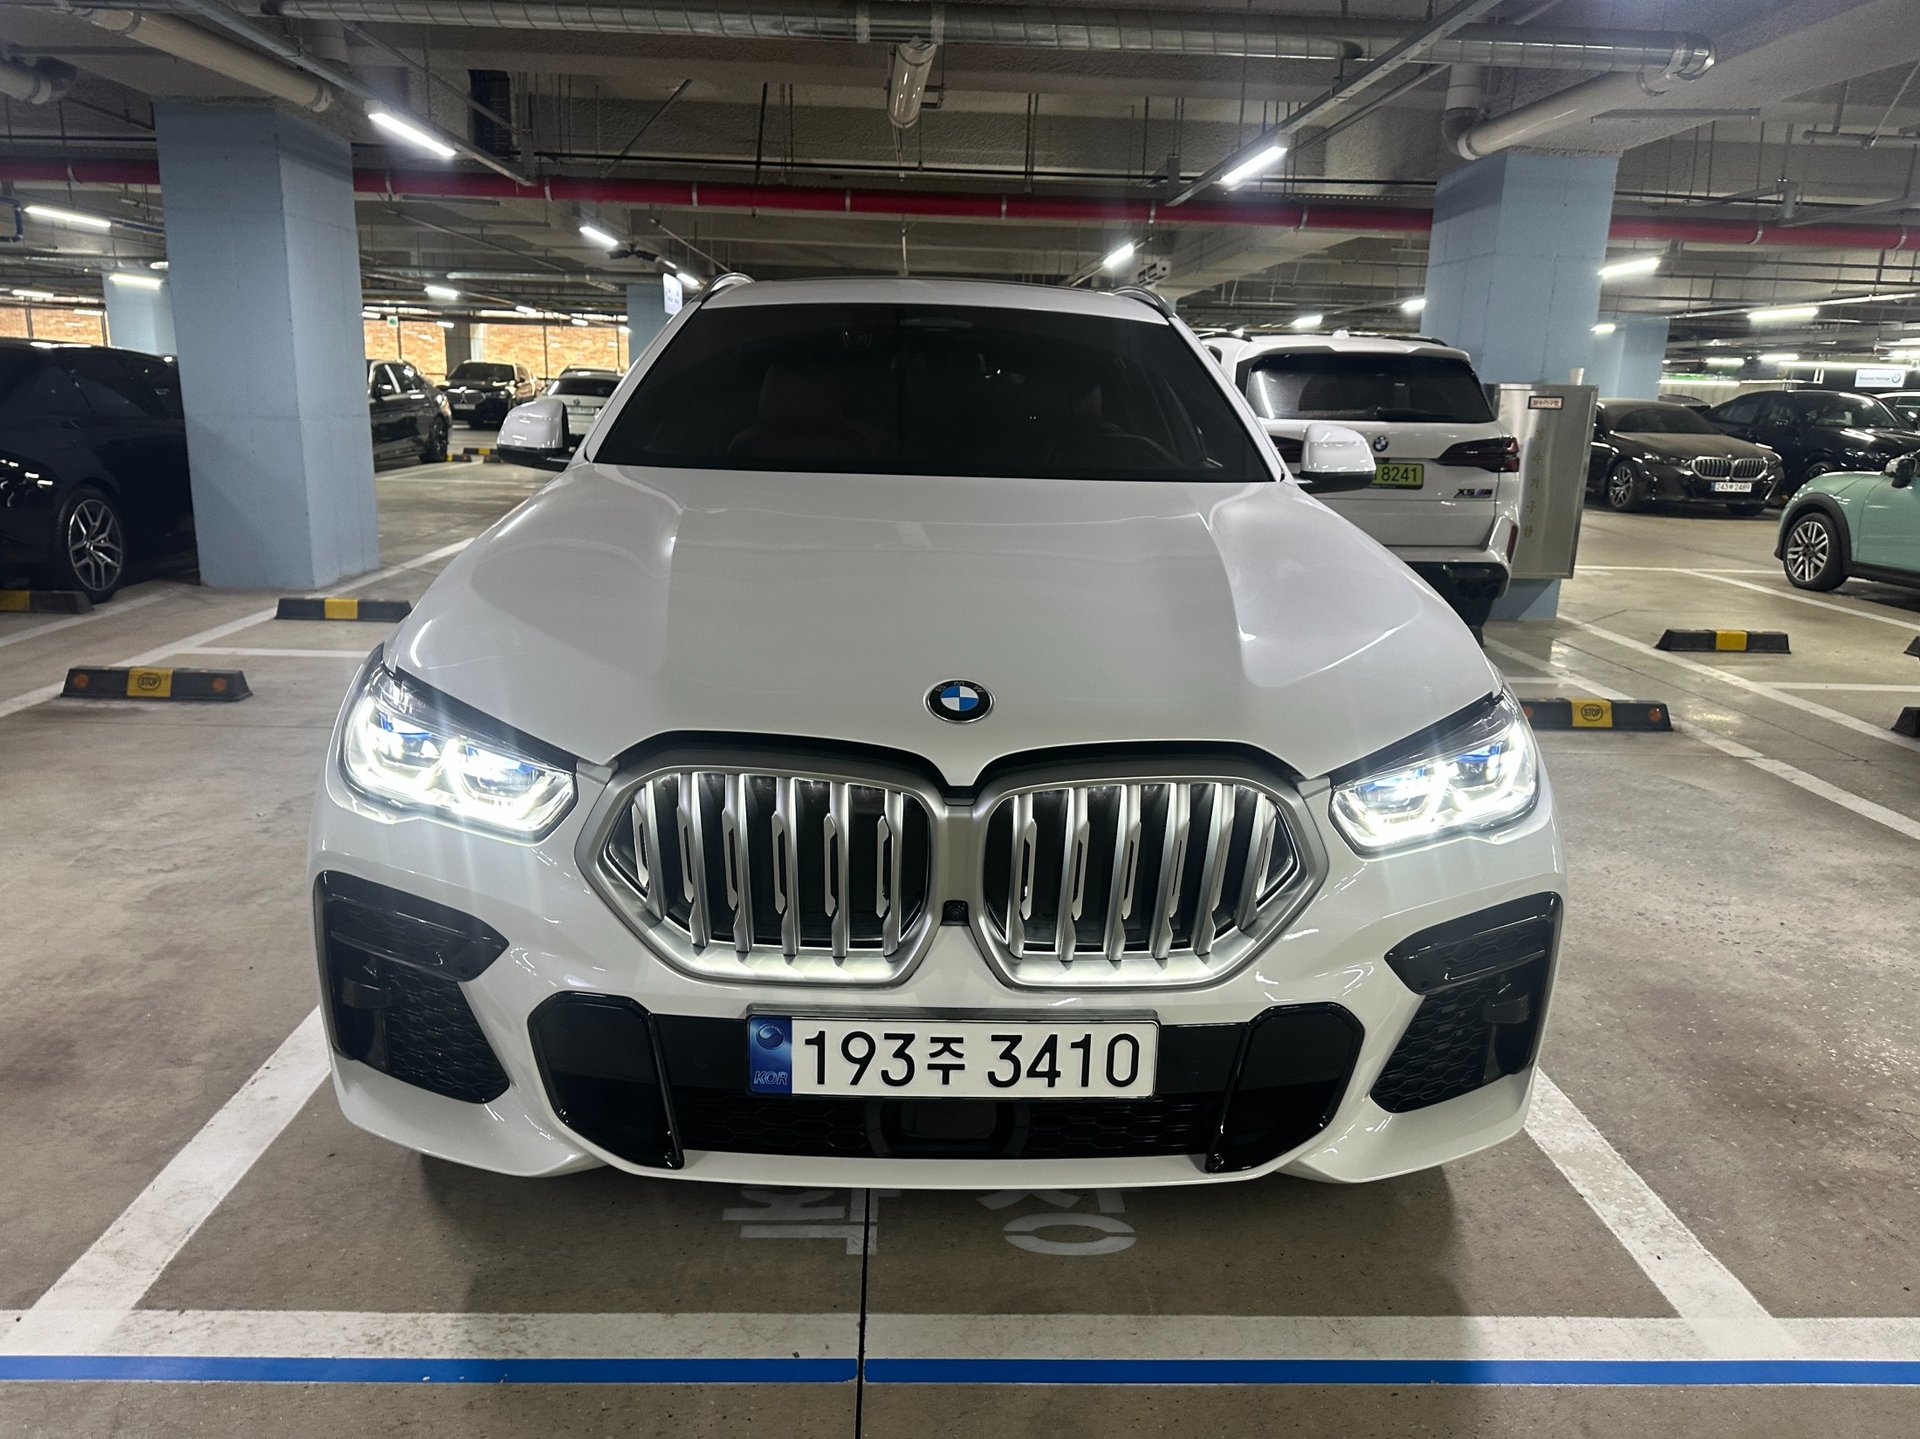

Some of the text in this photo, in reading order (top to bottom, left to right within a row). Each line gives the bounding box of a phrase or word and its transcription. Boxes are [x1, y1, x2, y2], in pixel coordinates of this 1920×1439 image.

[1381, 467, 1417, 482] 8241
[804, 1030, 1140, 1088] 193주 3410
[753, 1070, 788, 1085] KOR
